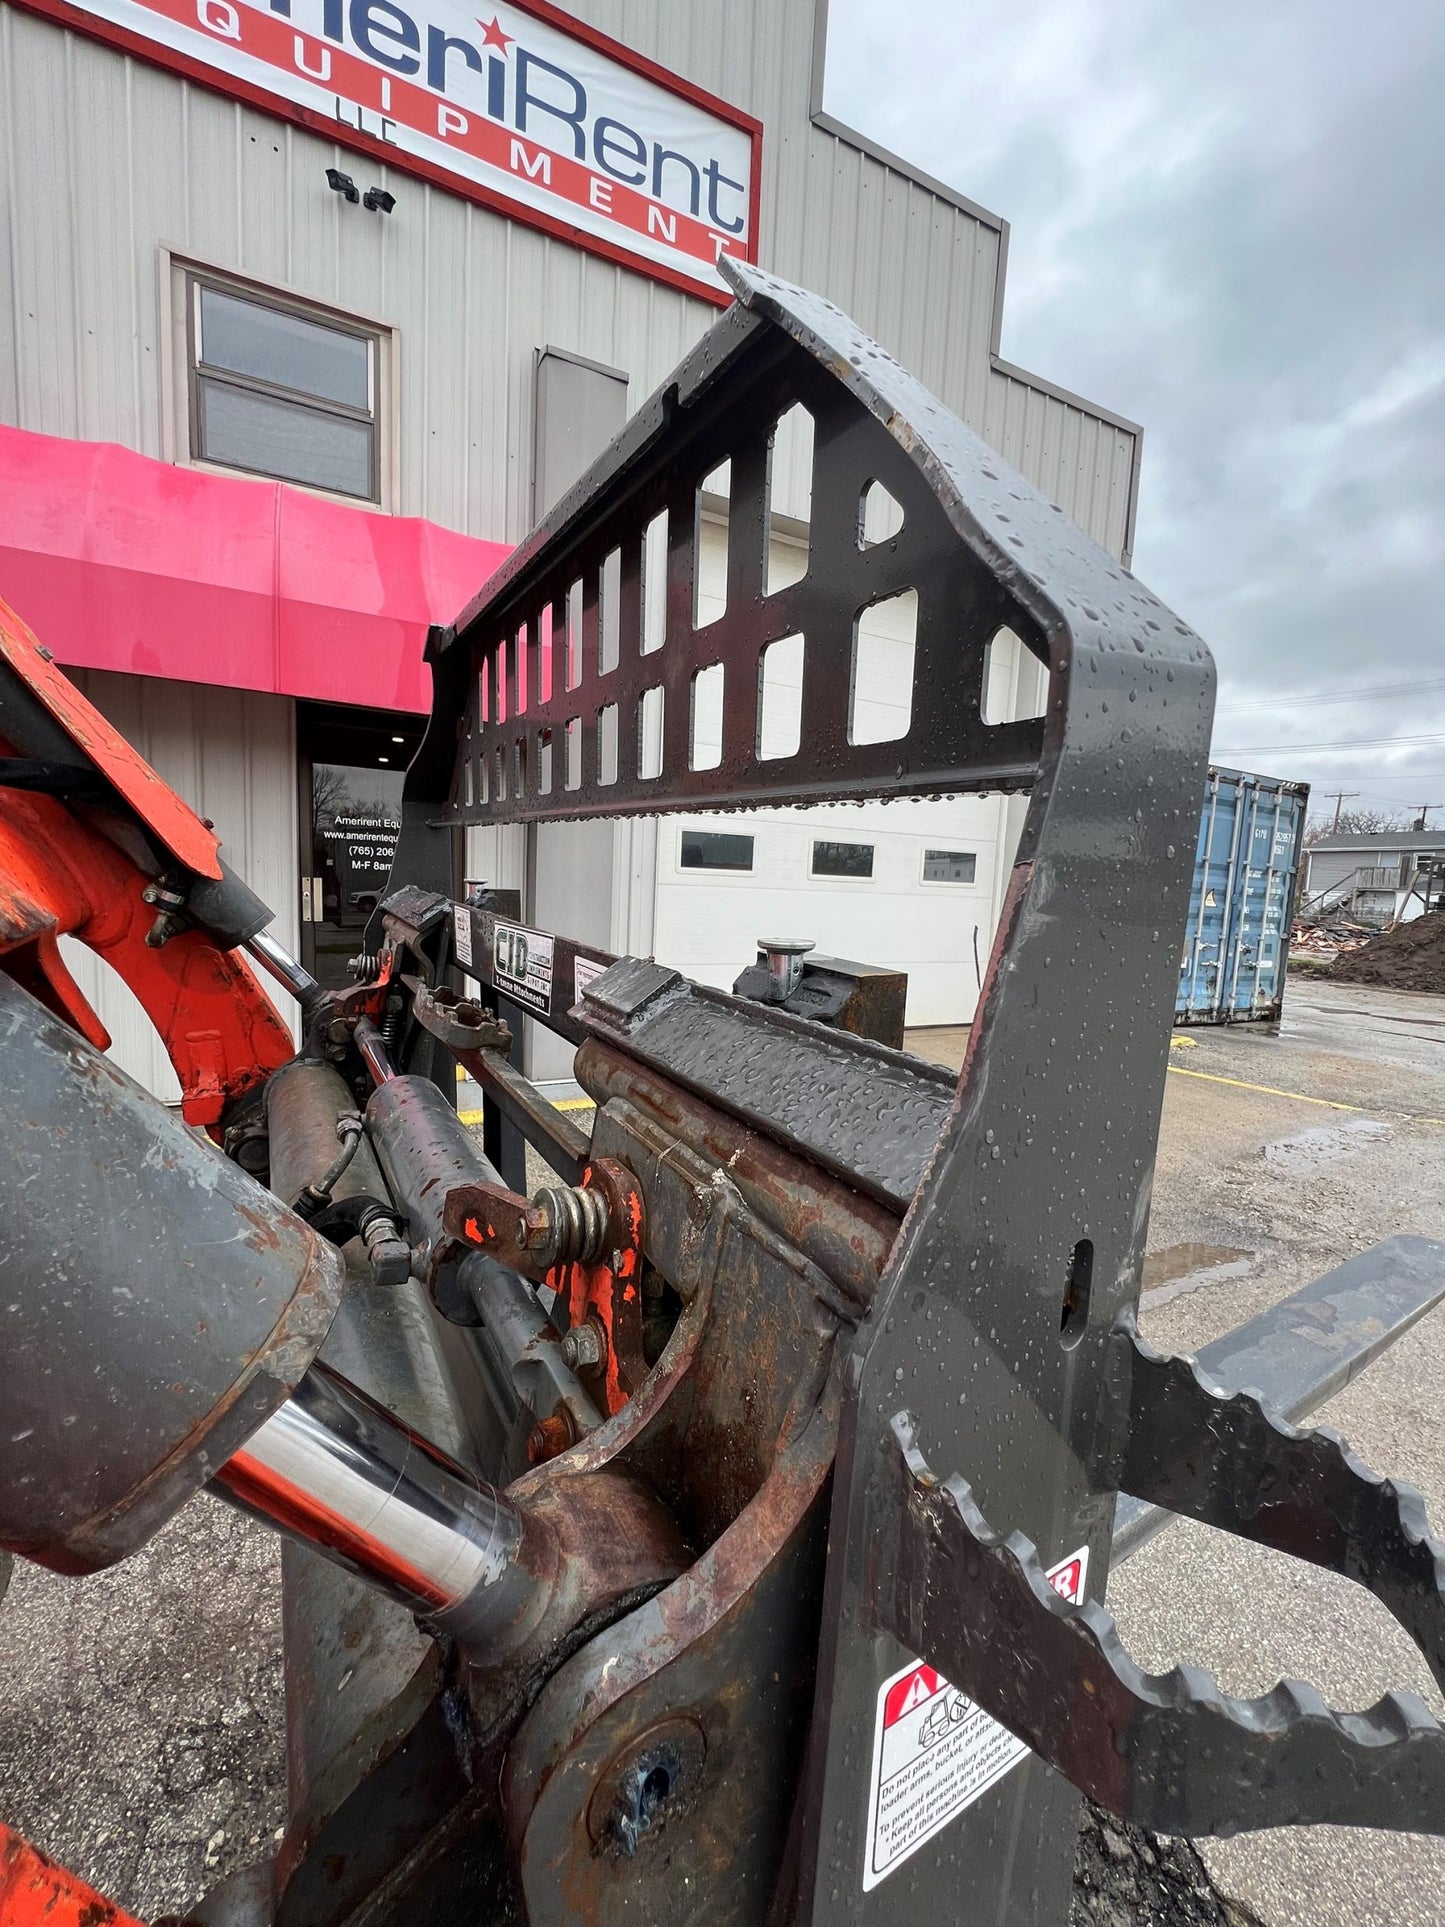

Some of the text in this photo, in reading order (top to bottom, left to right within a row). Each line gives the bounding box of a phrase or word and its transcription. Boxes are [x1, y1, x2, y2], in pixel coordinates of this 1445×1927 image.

[335, 96, 397, 145] LLC
[334, 816, 381, 827] Amerirent
[348, 846, 374, 857] (765)
[352, 860, 371, 870] M-F
[880, 1823, 890, 1836] To
[892, 1793, 924, 1828] prevent
[926, 1771, 954, 1799] serious
[956, 1750, 978, 1774] injury
[980, 1742, 988, 1754] or
[881, 1787, 912, 1814] loader
[910, 1770, 933, 1791] arms,
[965, 1735, 974, 1746] or
[882, 1785, 894, 1799] Do
[897, 1768, 910, 1788] not
[912, 1754, 935, 1778] place
[936, 1740, 951, 1757] any
[952, 1725, 968, 1746] part
[970, 1717, 978, 1730] of
[892, 1818, 912, 1841] Keep
[914, 1805, 925, 1820] all
[926, 1780, 958, 1813] persons
[960, 1764, 974, 1783] and
[976, 1744, 1002, 1770] objects
[890, 1834, 907, 1858] part
[908, 1824, 918, 1839] of
[919, 1813, 934, 1830] this
[936, 1784, 968, 1815] machine
[970, 1778, 976, 1788] is
[978, 1766, 986, 1781] in
